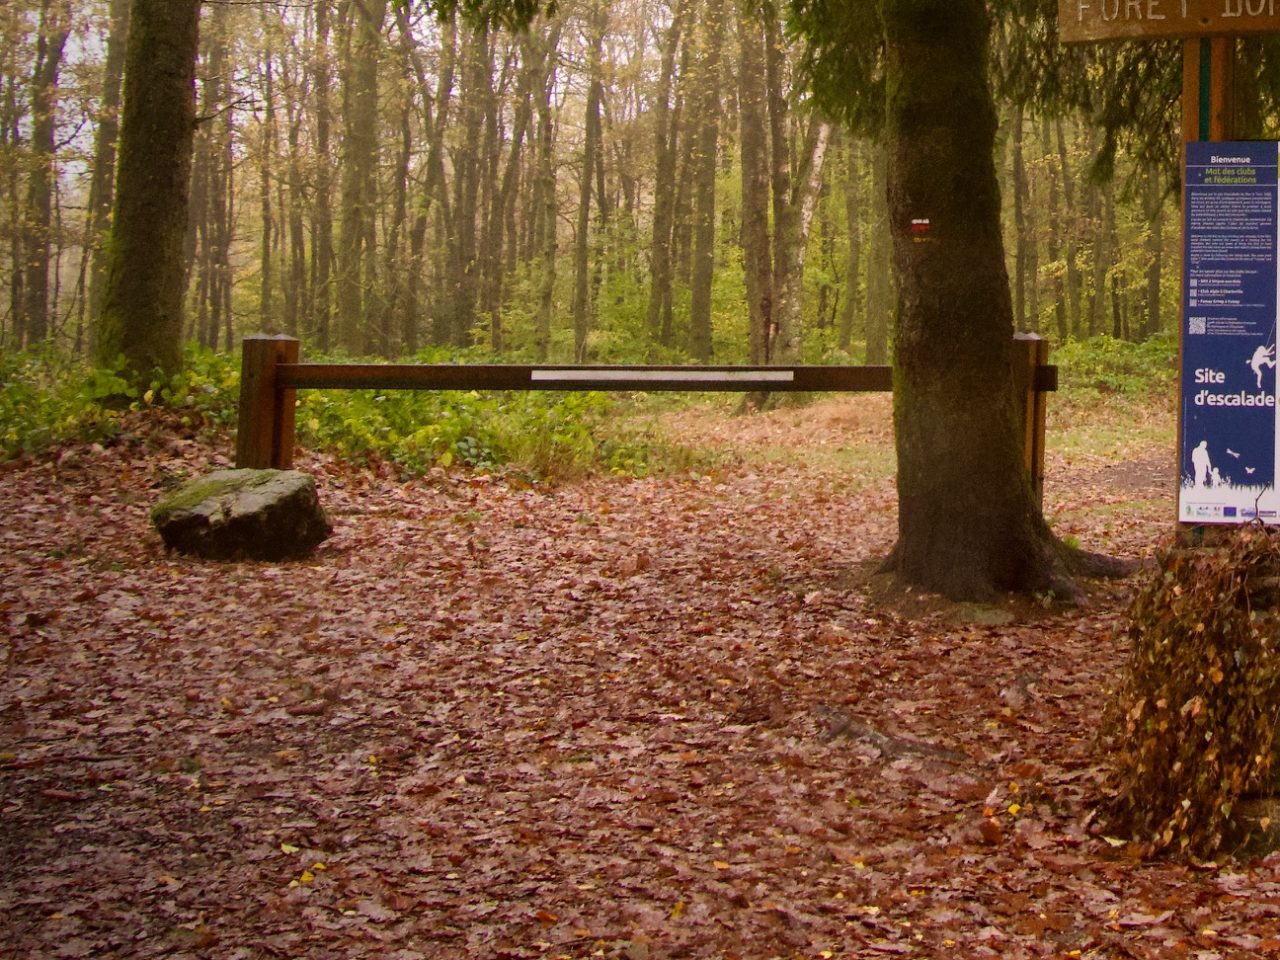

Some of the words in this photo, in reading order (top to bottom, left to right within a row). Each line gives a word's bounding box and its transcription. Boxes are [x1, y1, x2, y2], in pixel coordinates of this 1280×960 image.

[1211, 156, 1251, 164] Bienvenue
[1205, 168, 1221, 176] Mot
[1222, 168, 1236, 176] des
[1237, 168, 1257, 176] clubs
[1195, 368, 1226, 384] Site
[1195, 391, 1275, 407] d'escalade
